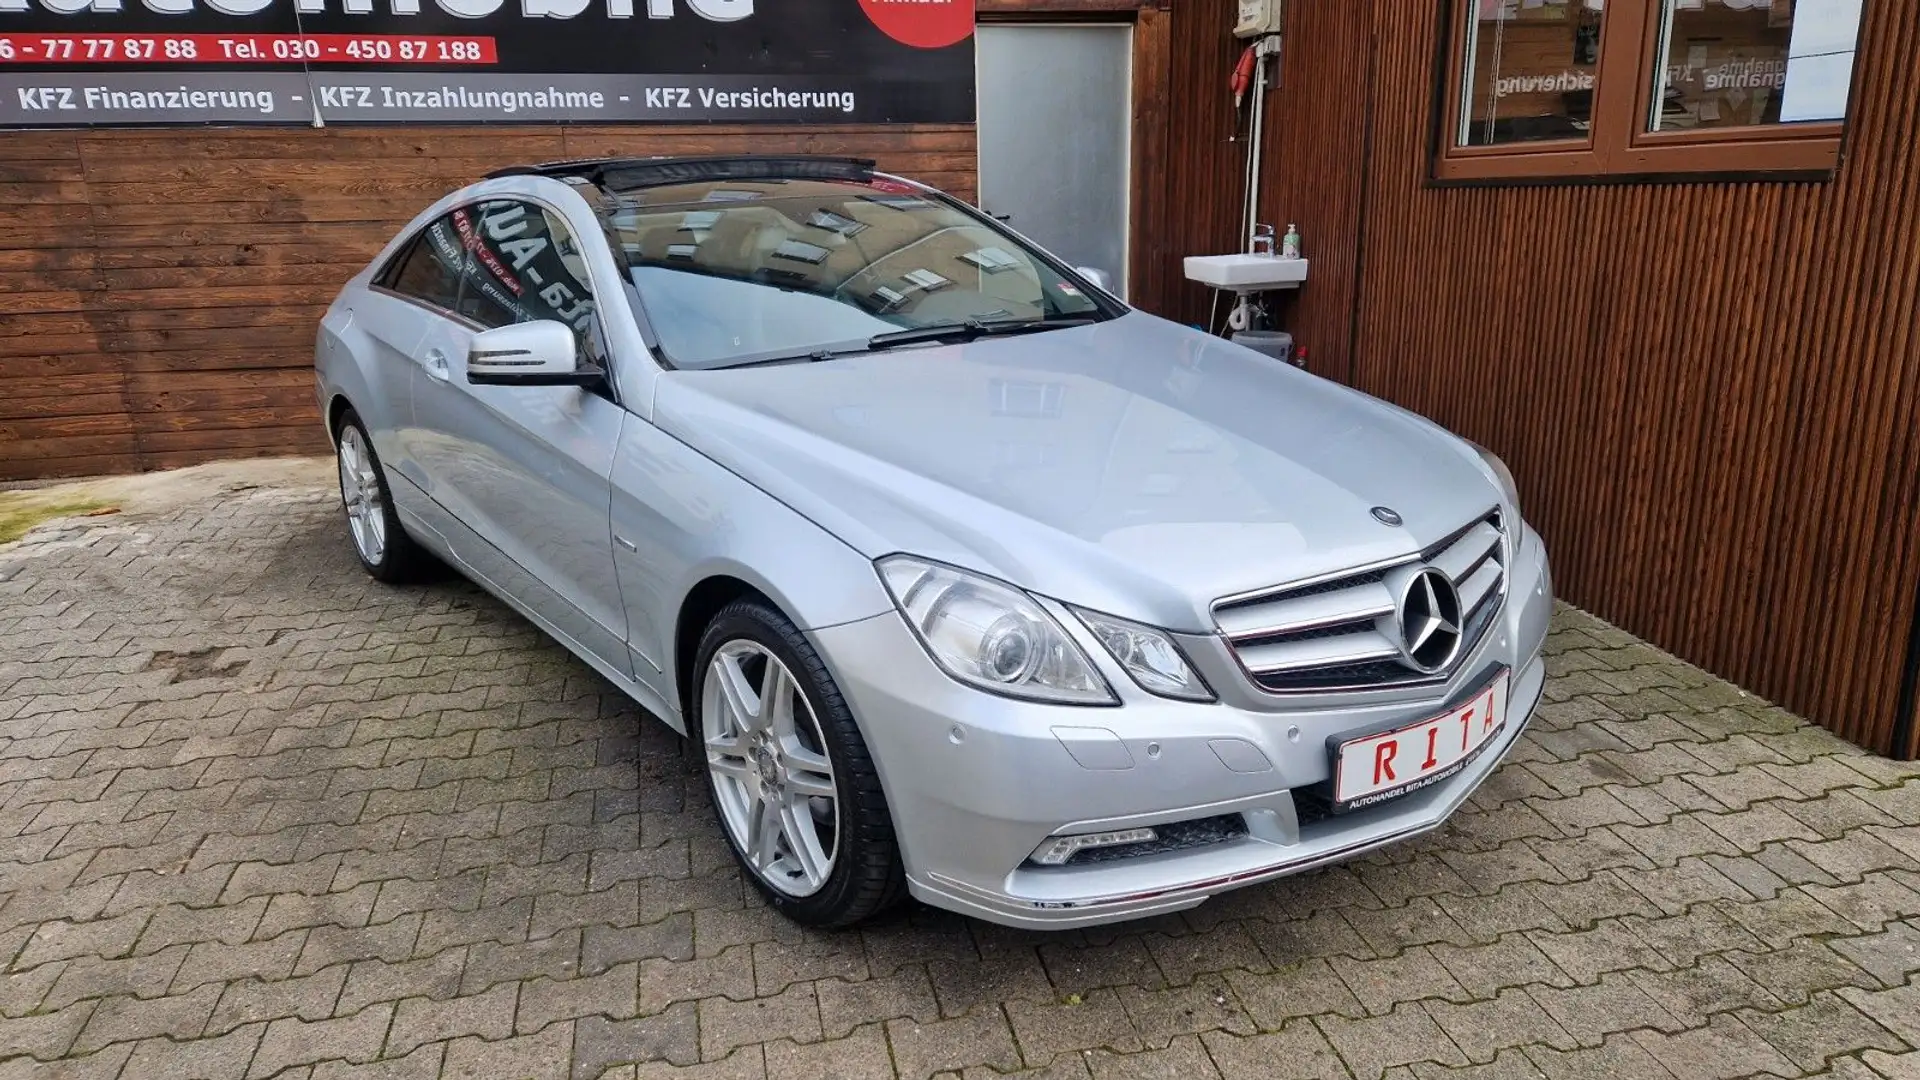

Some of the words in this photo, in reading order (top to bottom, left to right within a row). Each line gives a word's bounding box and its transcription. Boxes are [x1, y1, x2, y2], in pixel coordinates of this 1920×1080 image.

[41, 39, 74, 59] 77
[82, 39, 115, 58] 77
[123, 38, 155, 59] 87
[165, 39, 197, 59] 88
[218, 38, 266, 60] Tel.
[272, 39, 320, 60] 030
[345, 40, 392, 60] 450
[399, 40, 428, 60] 87
[437, 41, 481, 60] 188
[18, 87, 77, 110] KFZ
[83, 86, 274, 114] Finanzierung
[320, 86, 375, 108] KFZ
[380, 86, 604, 113] Inzahlungnahme
[645, 87, 692, 108] KFZ
[697, 87, 855, 113] Versicherung
[1349, 786, 1405, 810] AUTOHANDEL
